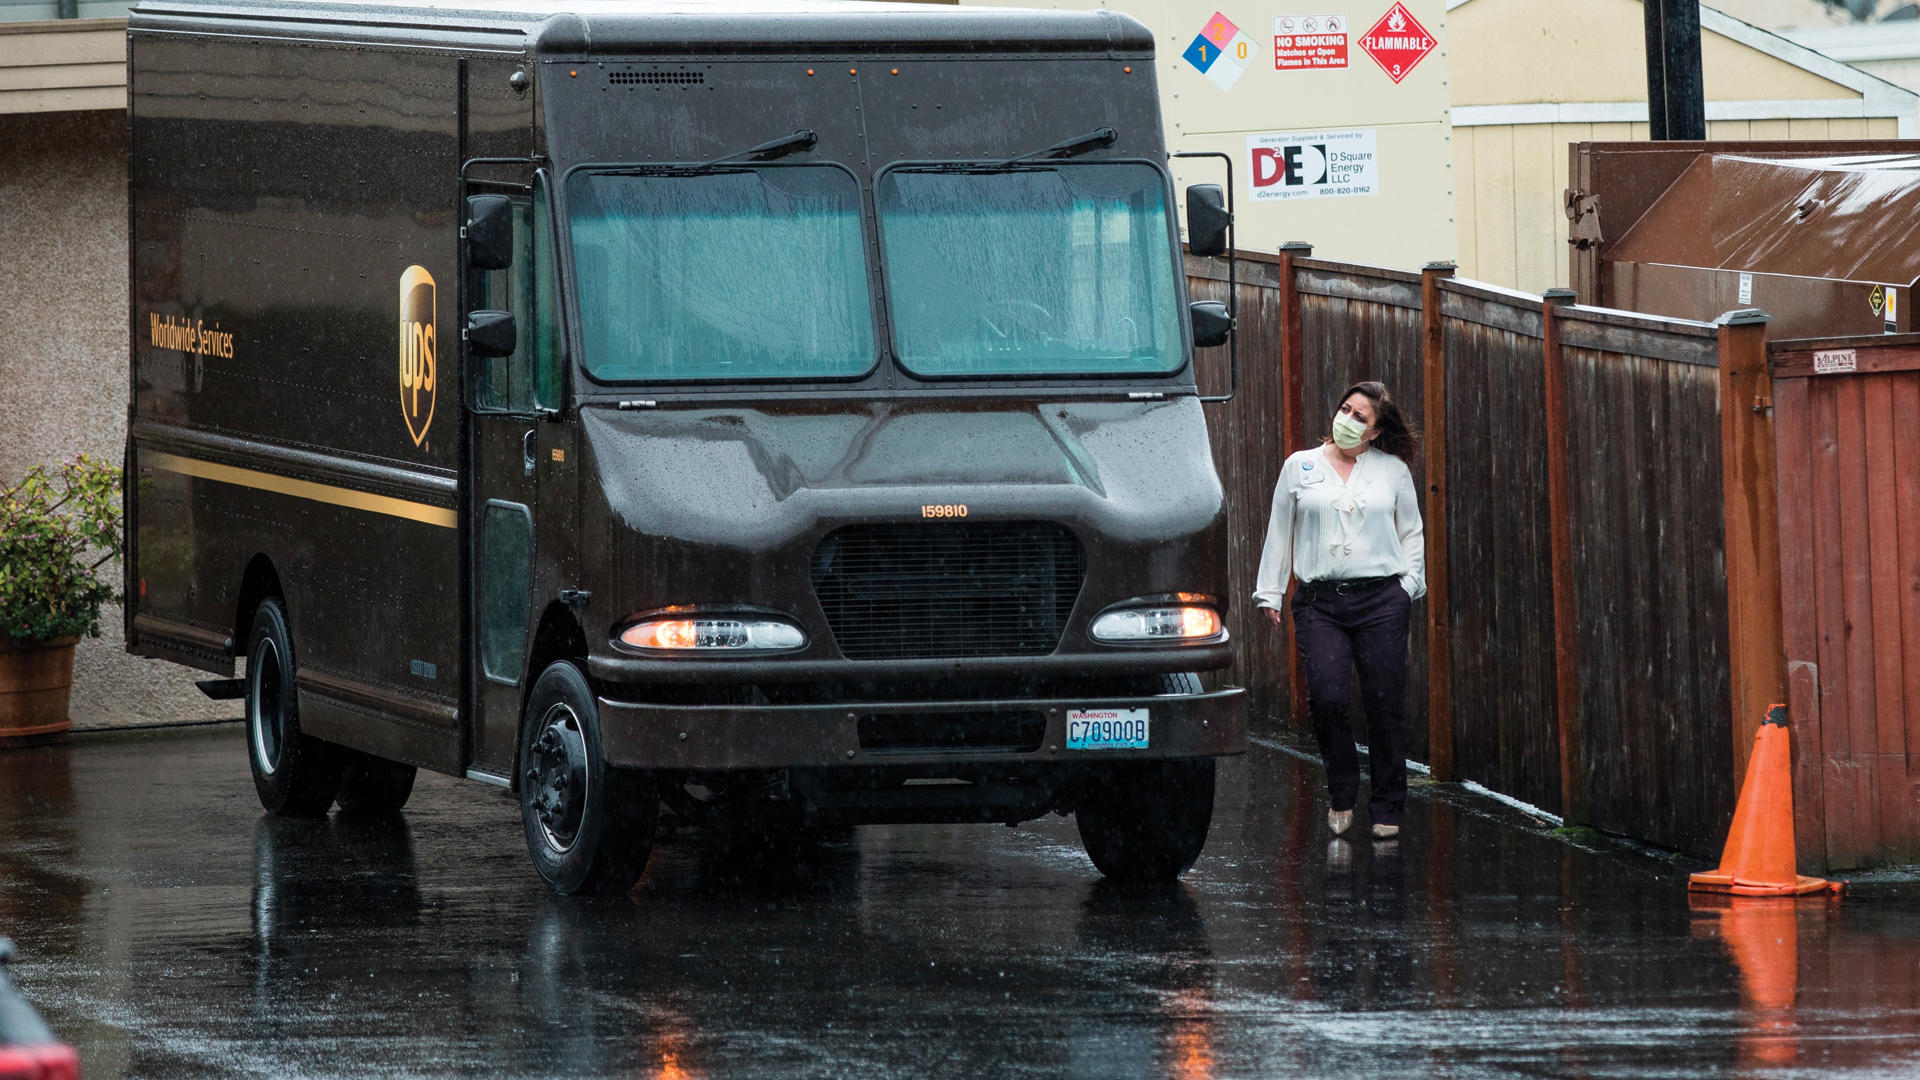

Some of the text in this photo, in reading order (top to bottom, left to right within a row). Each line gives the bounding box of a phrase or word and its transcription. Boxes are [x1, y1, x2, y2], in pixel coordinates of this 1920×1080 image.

[1213, 23, 1224, 40] 2
[1276, 35, 1345, 47] NO SMOKING
[1366, 36, 1428, 50] FLAMMABLE
[1198, 45, 1206, 62] 1
[1237, 41, 1247, 59] 0
[1277, 48, 1307, 57] Matches
[1316, 47, 1336, 57] Open
[1277, 58, 1303, 66] Flames
[1312, 56, 1328, 65] This
[1329, 56, 1346, 65] Area
[1392, 64, 1401, 75] 3
[1292, 134, 1318, 142] Supplied
[1326, 132, 1354, 140] Serviced
[1355, 132, 1363, 140] by
[1330, 151, 1373, 163] D Square
[1331, 163, 1364, 173] Energy
[1331, 174, 1351, 184] LLC
[1257, 186, 1371, 198] d2energy.com 800-820-0162
[150, 312, 234, 359] Worldwide Services
[1820, 353, 1854, 365] ALPINE
[402, 321, 434, 418] ups
[921, 504, 968, 518] 159810
[1070, 720, 1145, 742] C70900B
